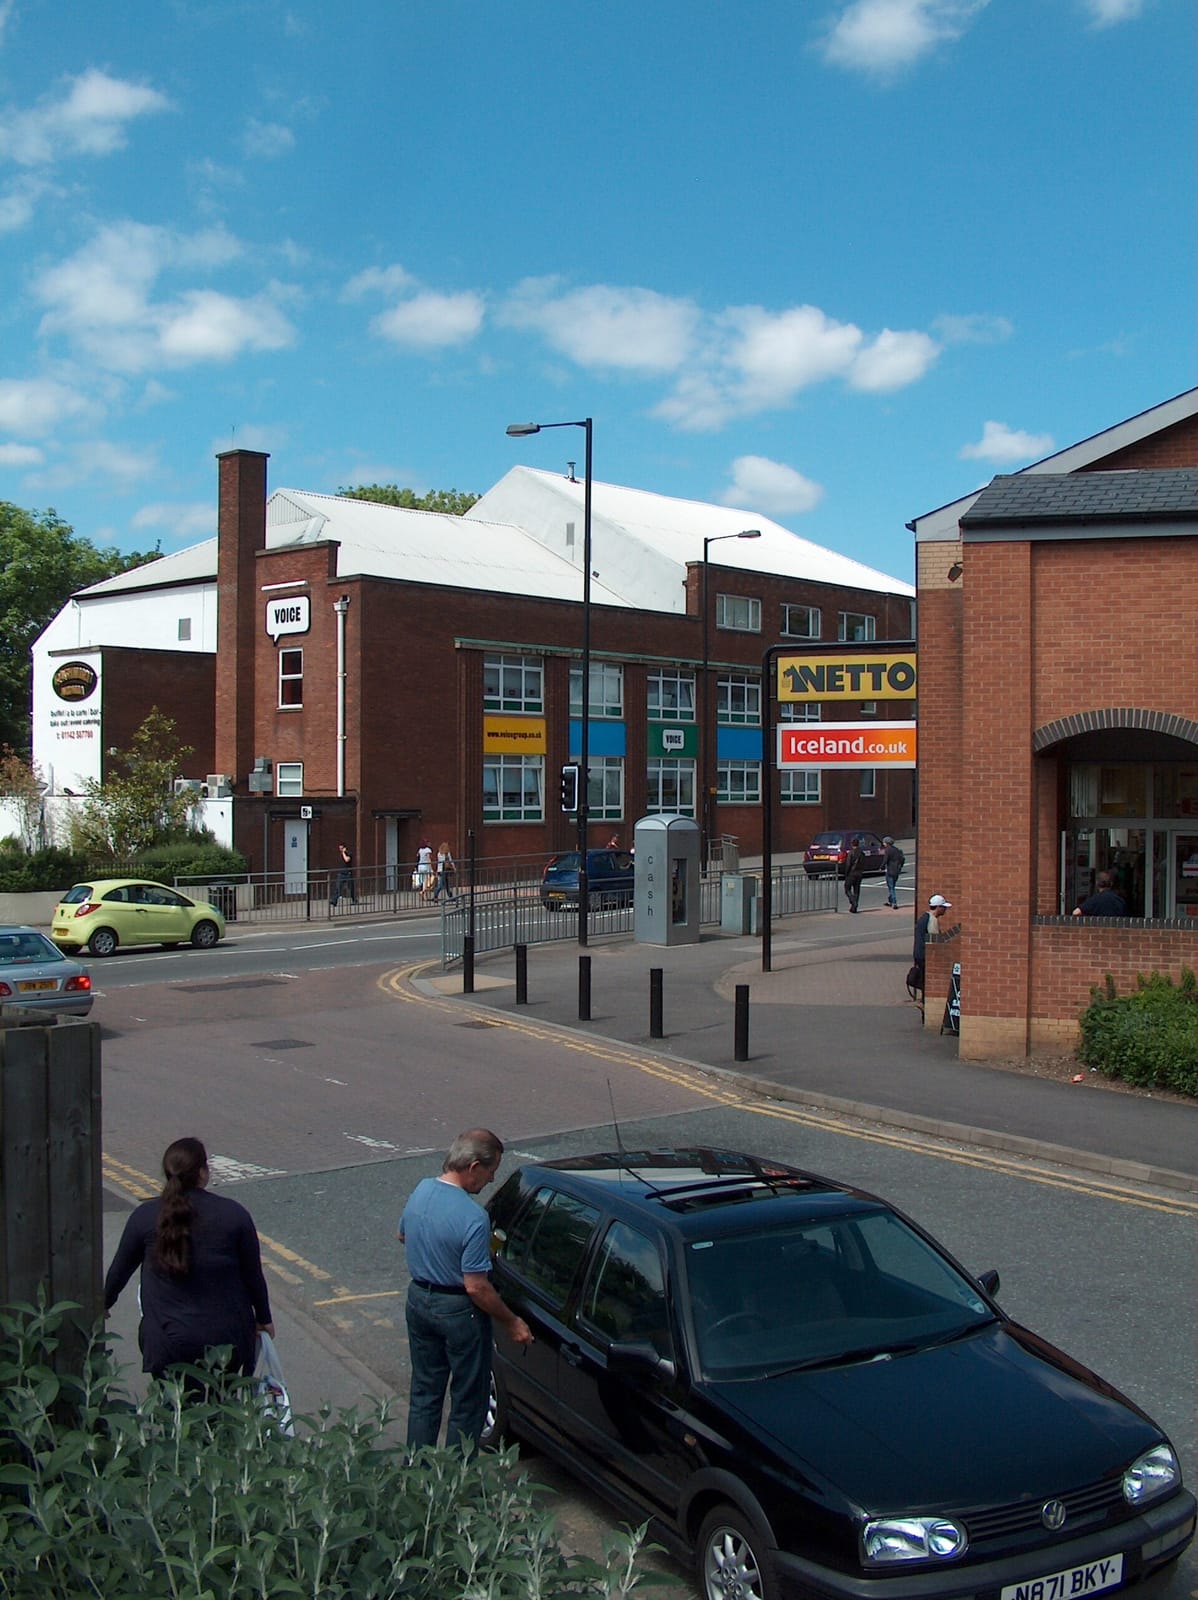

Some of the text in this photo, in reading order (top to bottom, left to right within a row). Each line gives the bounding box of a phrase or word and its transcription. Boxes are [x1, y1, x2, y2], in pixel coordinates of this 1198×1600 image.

[274, 607, 301, 624] VOICE
[785, 661, 916, 693] NETTO
[665, 734, 682, 744] VOICE
[790, 736, 907, 755] Iceland.co.uk
[1070, 1560, 1111, 1594] BKY
